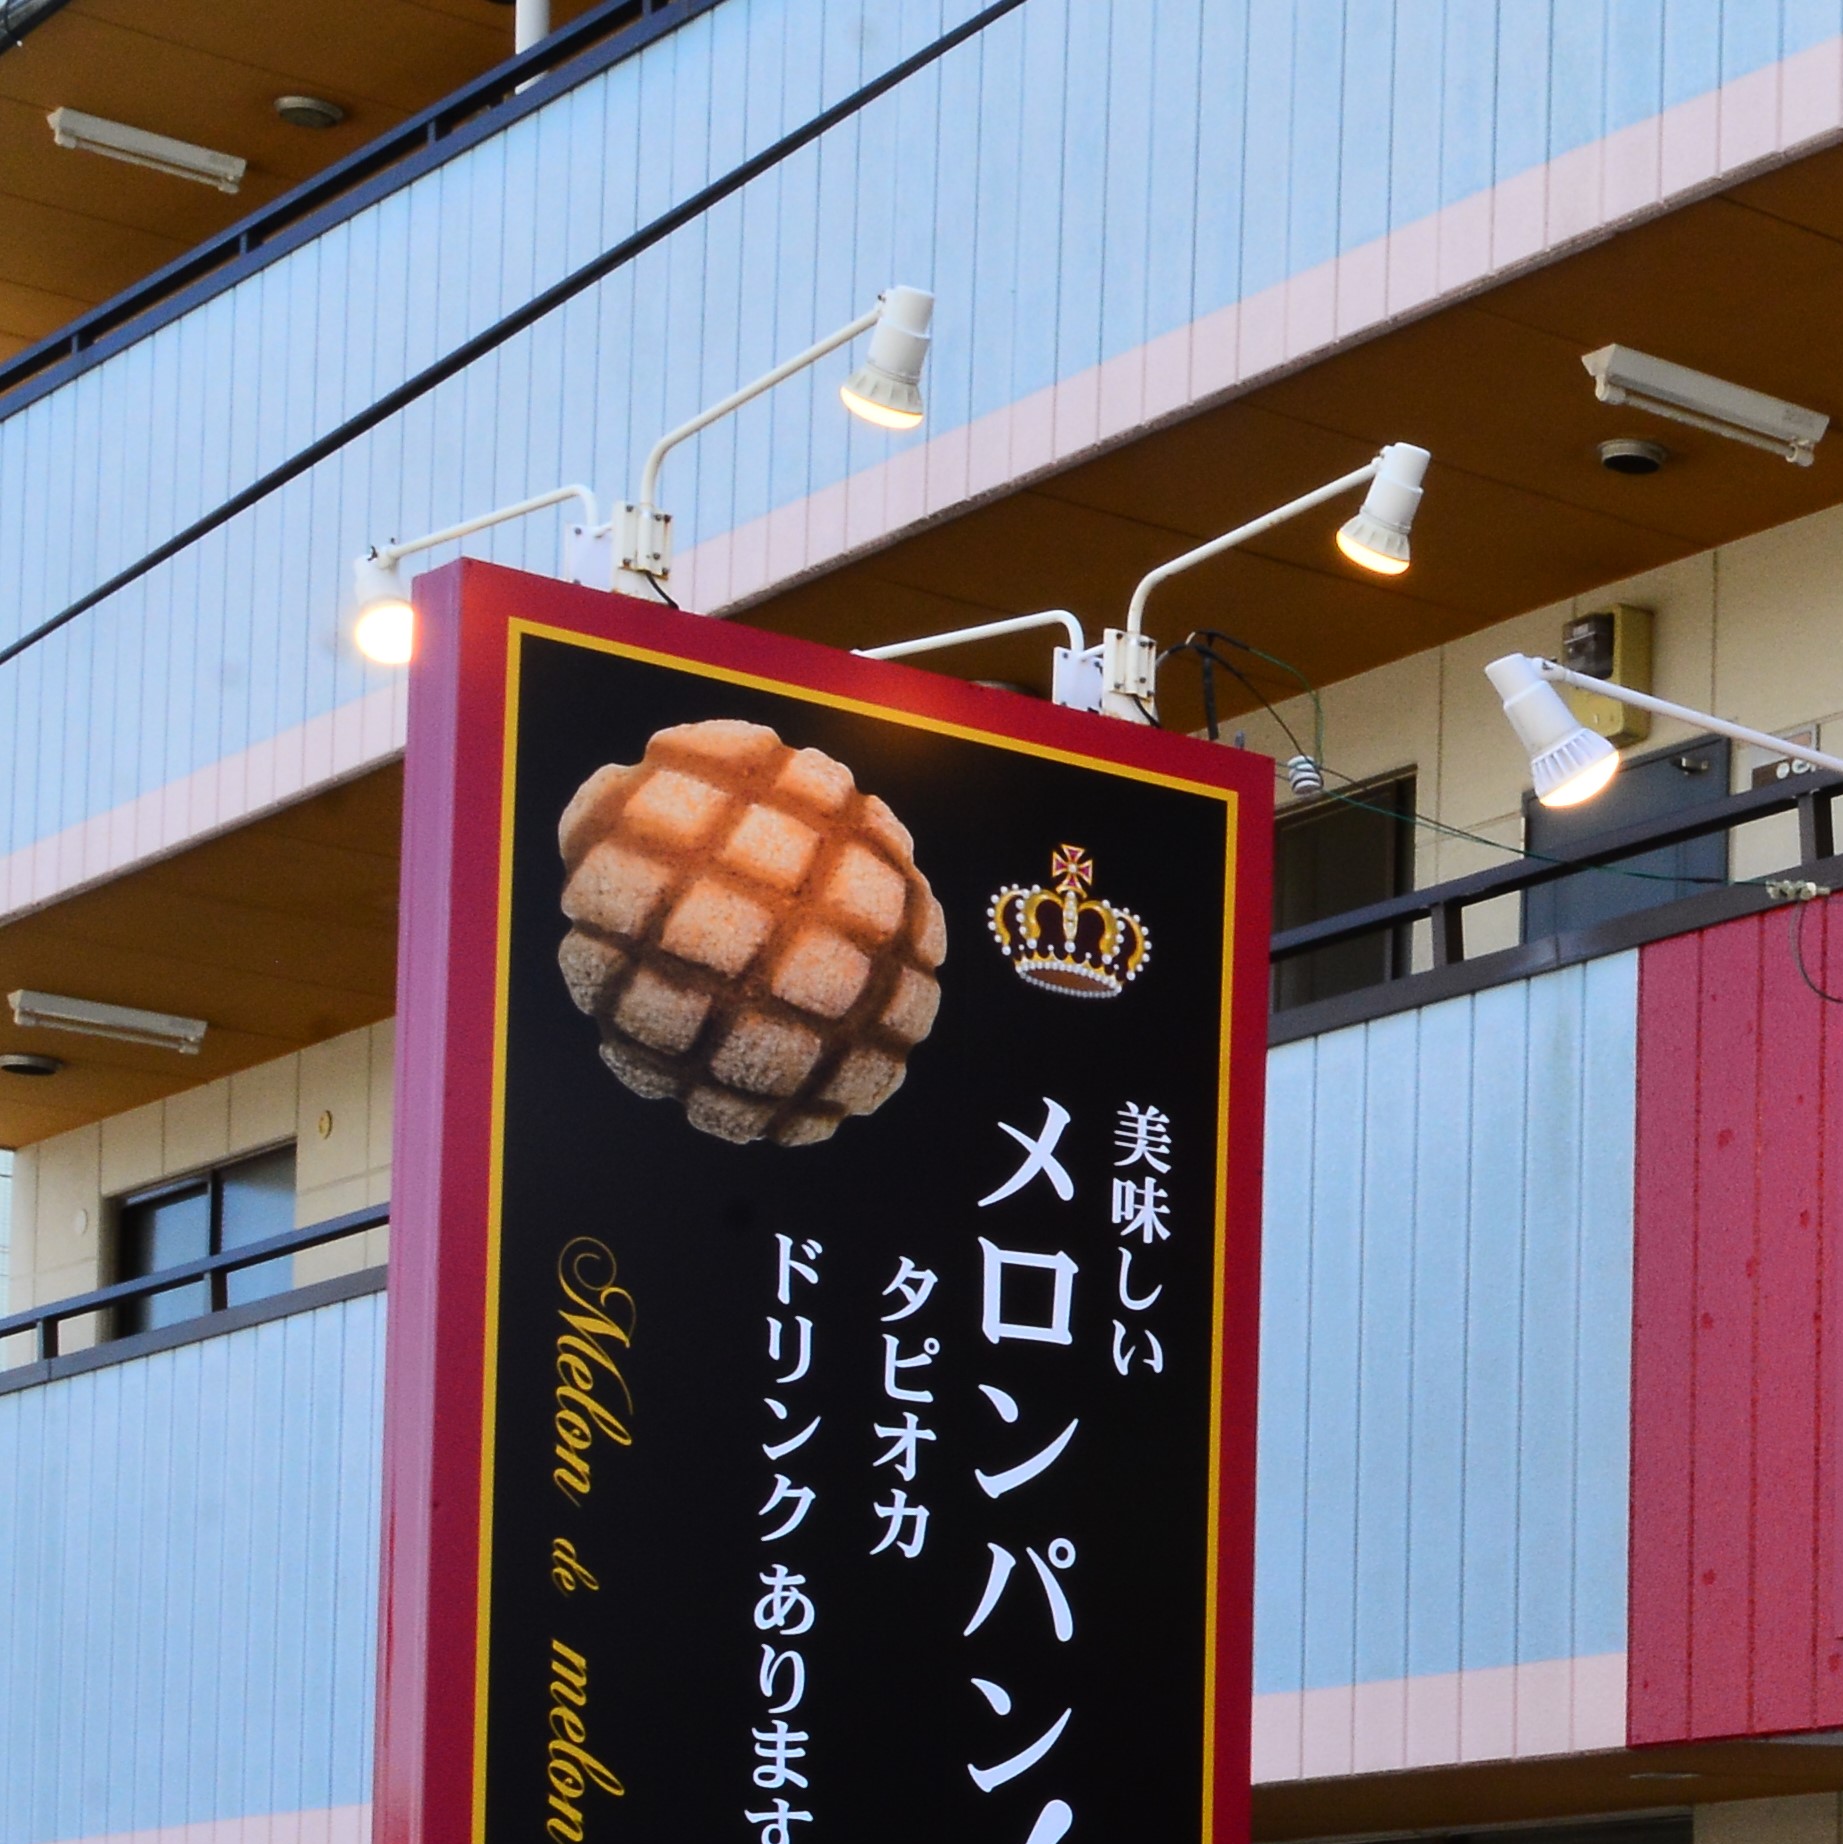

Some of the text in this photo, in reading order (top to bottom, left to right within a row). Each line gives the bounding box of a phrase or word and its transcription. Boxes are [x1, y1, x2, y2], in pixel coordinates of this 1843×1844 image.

[552, 1235, 638, 1506] Melon
[1110, 1099, 1173, 1377] 美味しい
[868, 1254, 941, 1560] タピオカ
[551, 1535, 601, 1600] de
